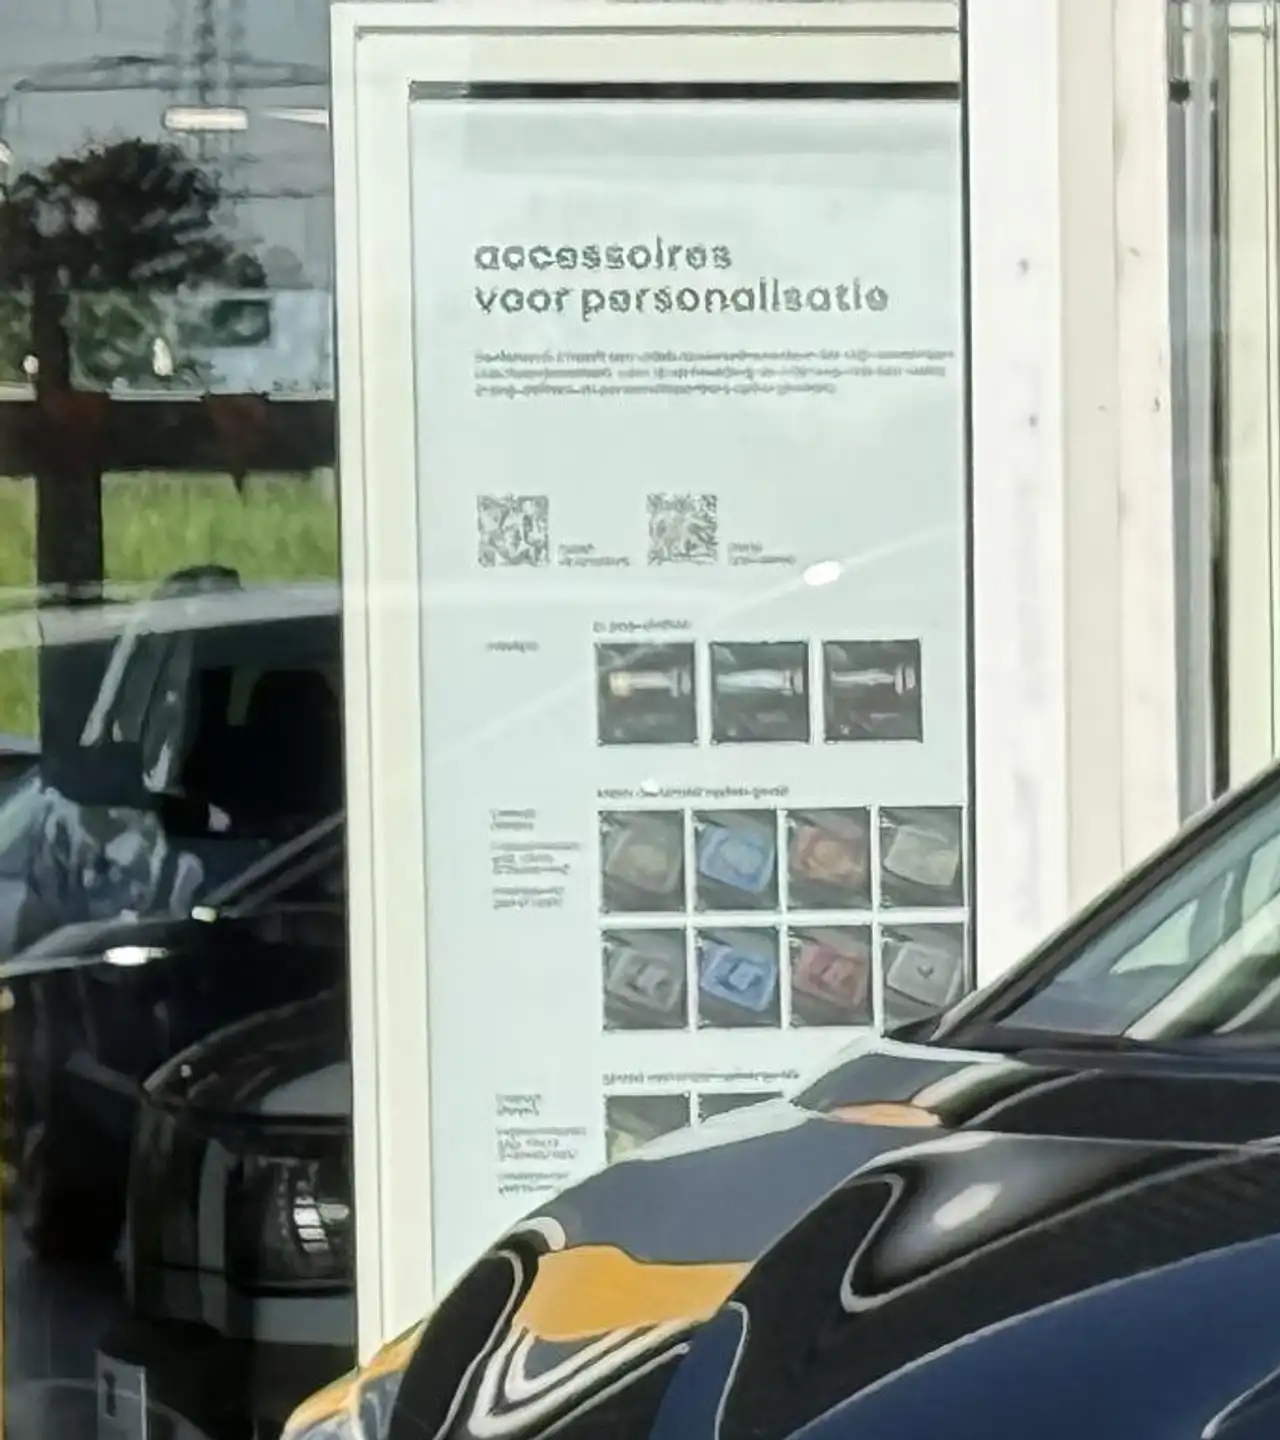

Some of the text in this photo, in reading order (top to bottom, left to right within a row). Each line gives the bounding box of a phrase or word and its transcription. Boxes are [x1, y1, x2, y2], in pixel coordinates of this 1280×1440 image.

[474, 236, 733, 270] accessoires
[474, 277, 890, 321] voor personalisatie
